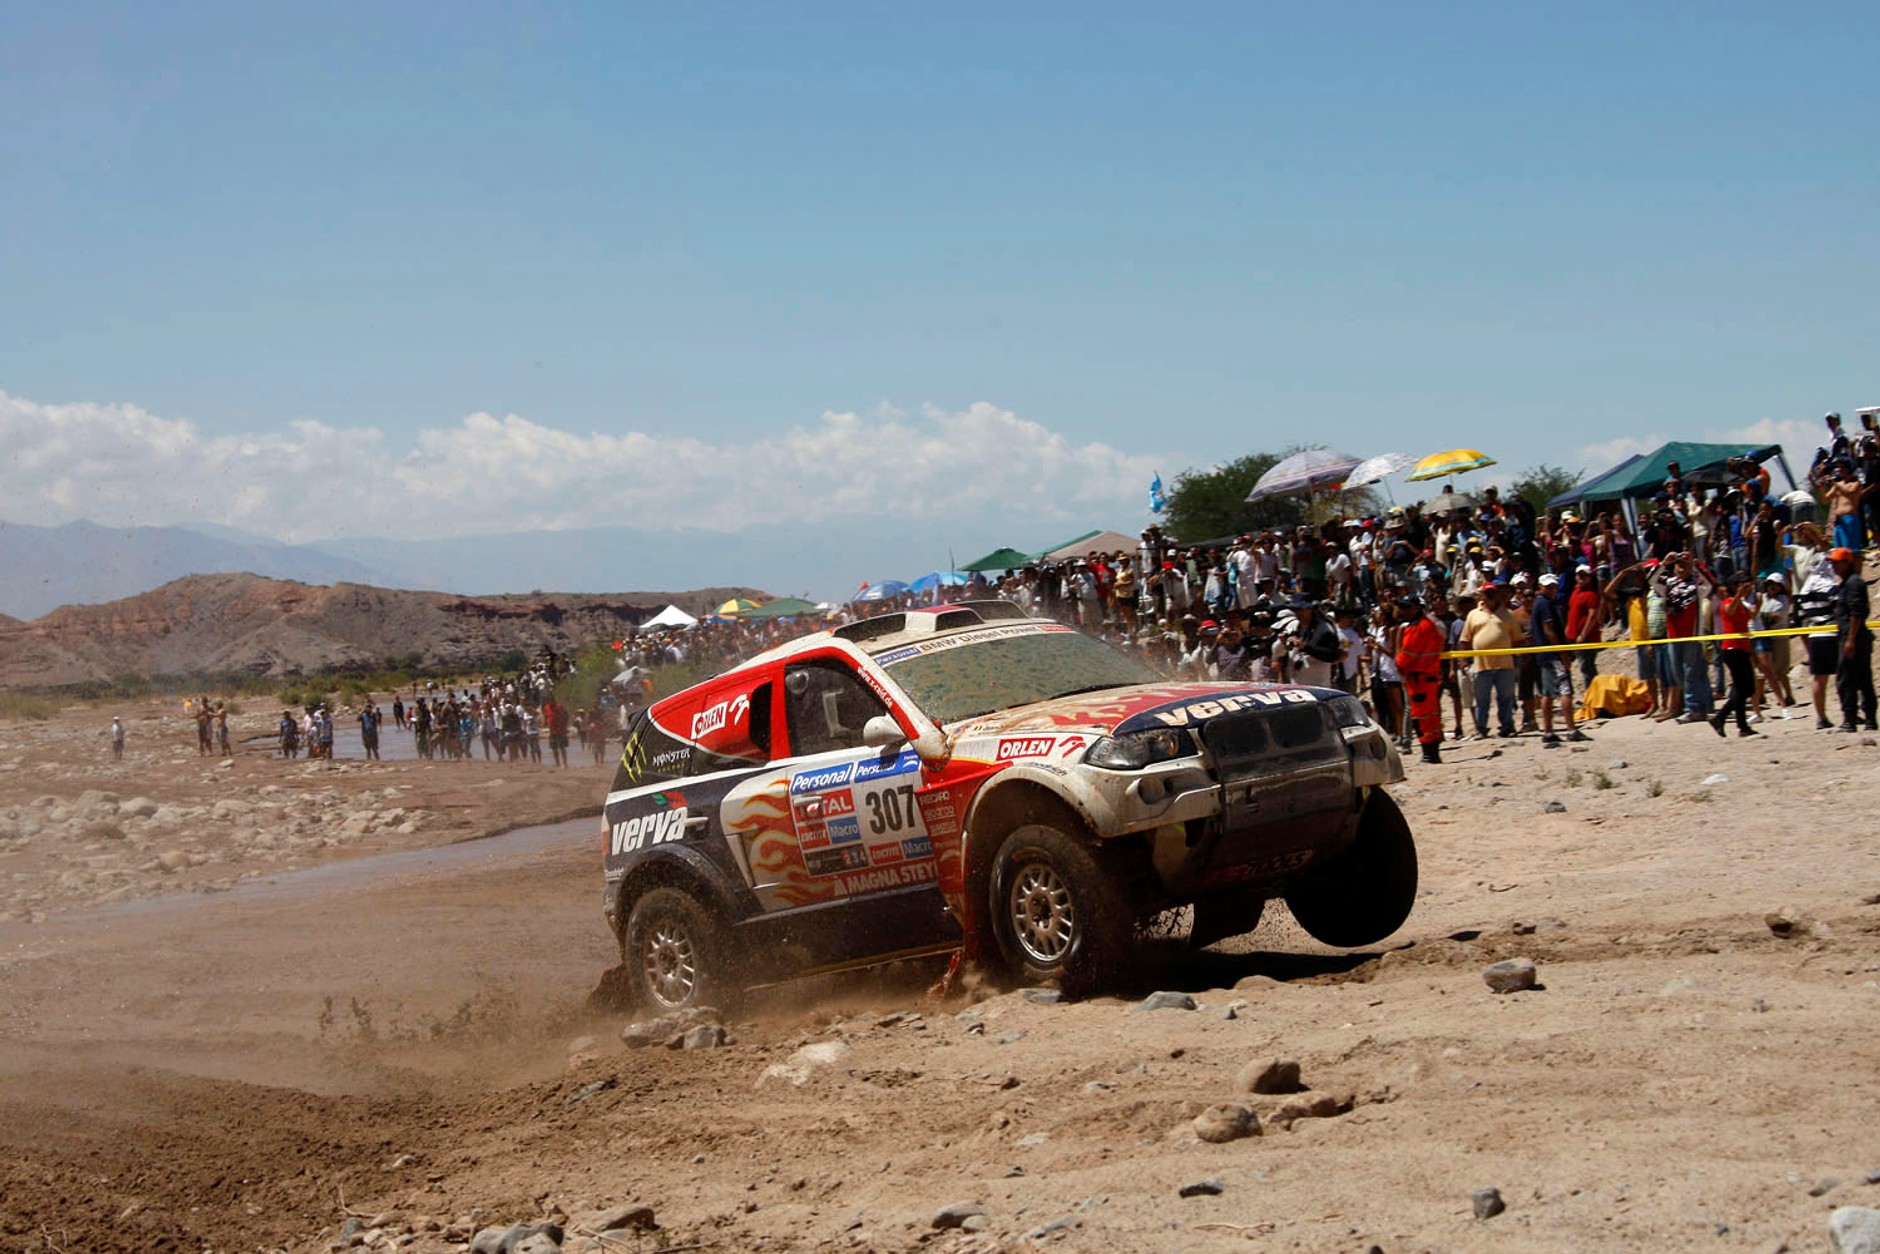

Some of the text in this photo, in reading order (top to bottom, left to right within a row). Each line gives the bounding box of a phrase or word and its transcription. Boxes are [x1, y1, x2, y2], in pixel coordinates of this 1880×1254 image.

[920, 637, 957, 653] BMW
[1154, 689, 1317, 726] verva
[652, 748, 690, 767] MONSTER
[1000, 740, 1051, 758] ORLEN
[793, 764, 852, 792] Personal
[865, 784, 916, 835] 307
[611, 806, 688, 856] verva
[829, 823, 858, 837] Macro
[849, 868, 901, 892] MAGNA
